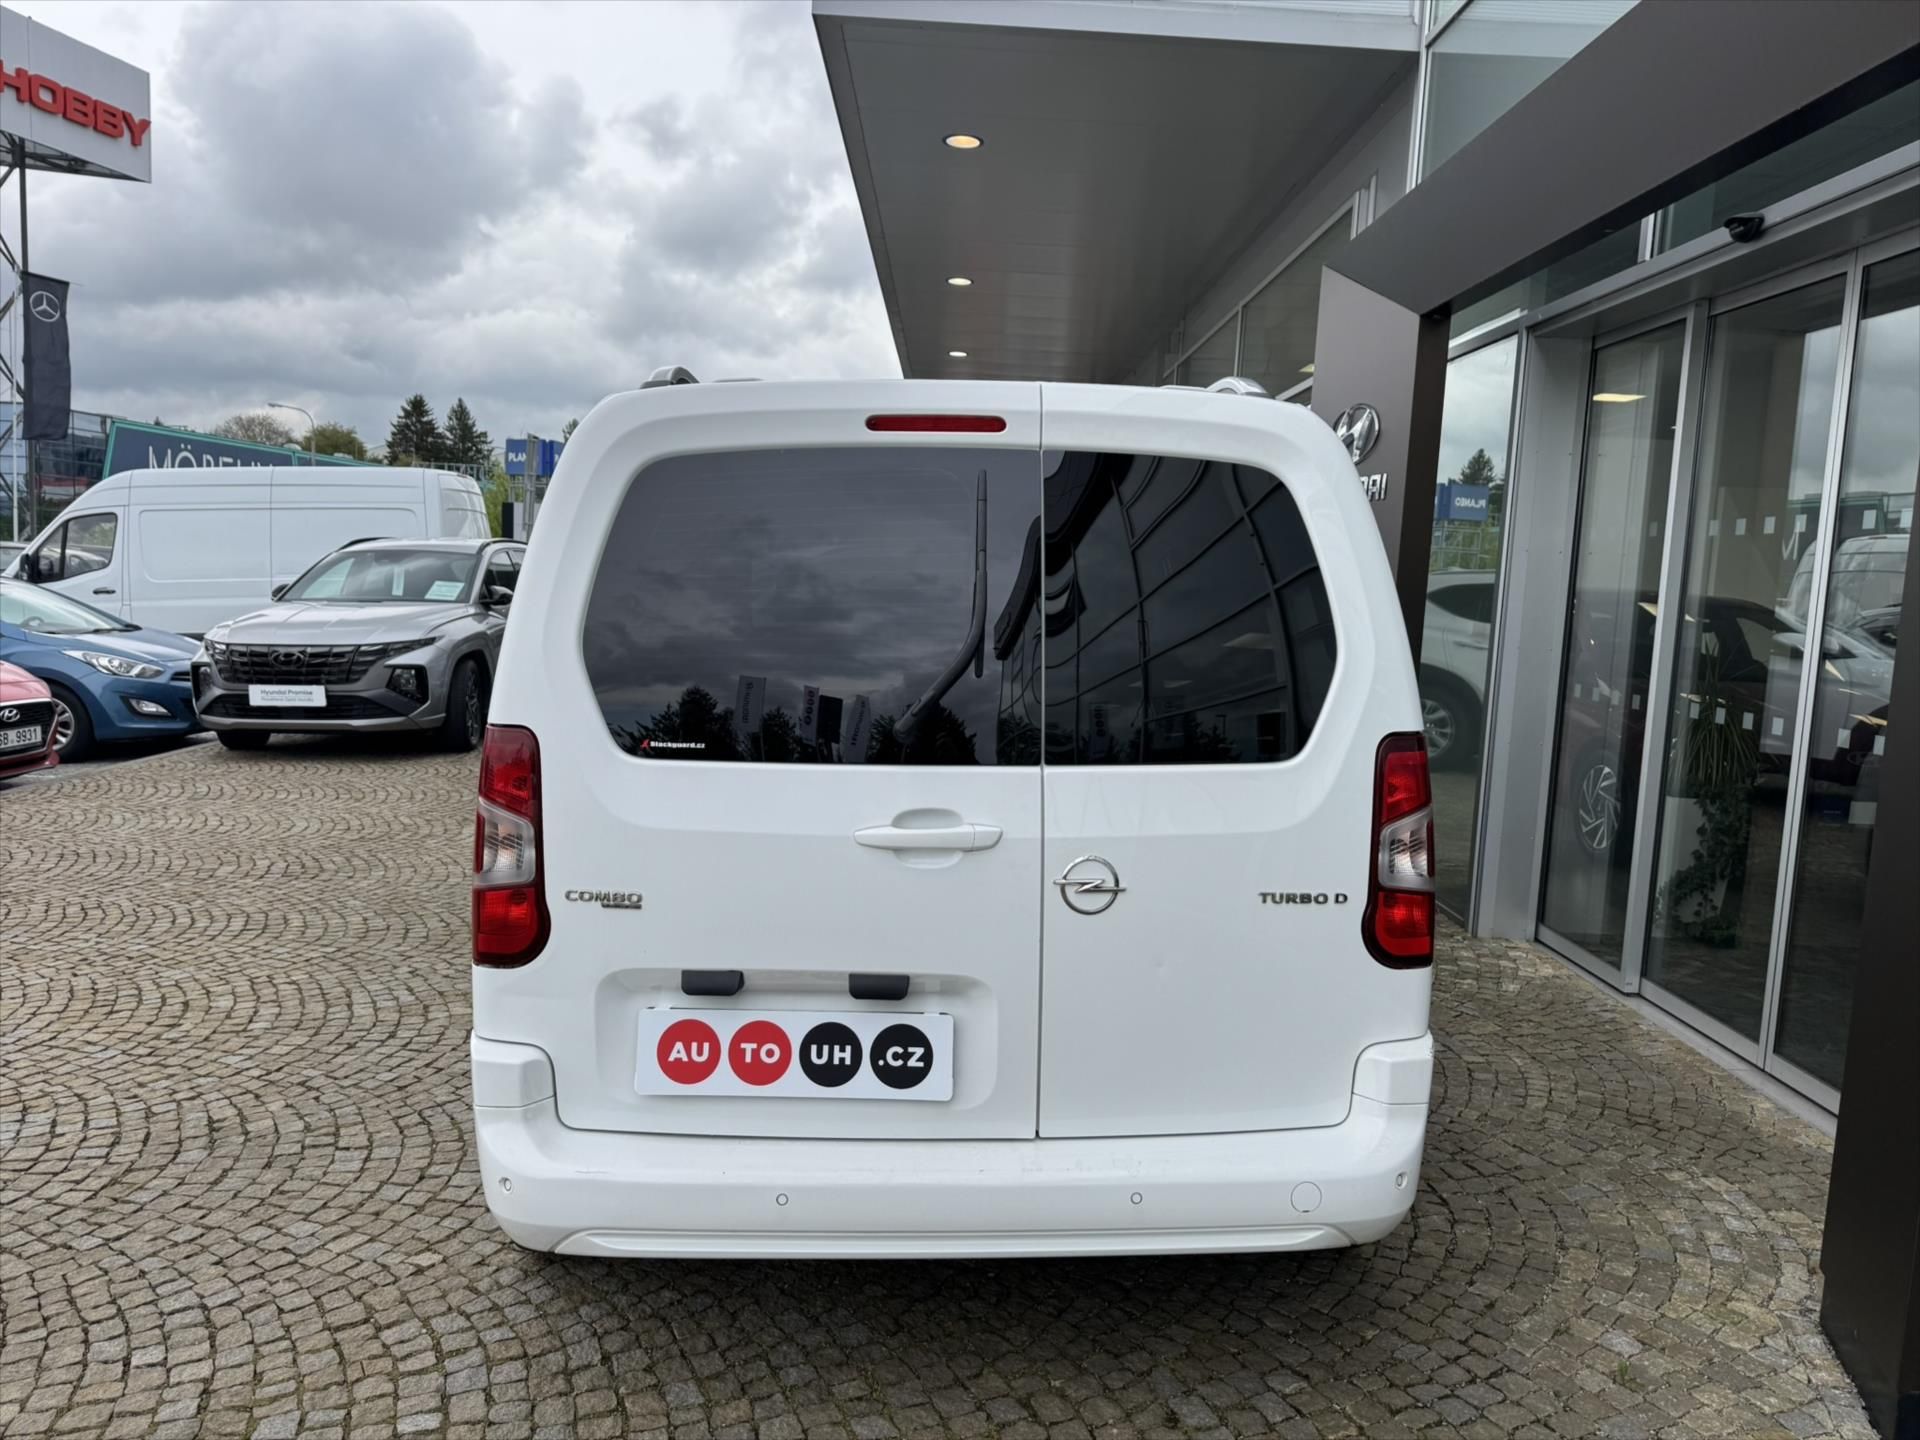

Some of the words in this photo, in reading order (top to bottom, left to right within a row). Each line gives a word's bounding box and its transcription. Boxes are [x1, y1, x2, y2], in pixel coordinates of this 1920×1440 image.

[0, 59, 152, 147] HOBBY
[16, 727, 37, 743] 9931
[565, 890, 643, 904] COMBO
[1258, 892, 1329, 905] TURBO
[1334, 892, 1348, 905] D
